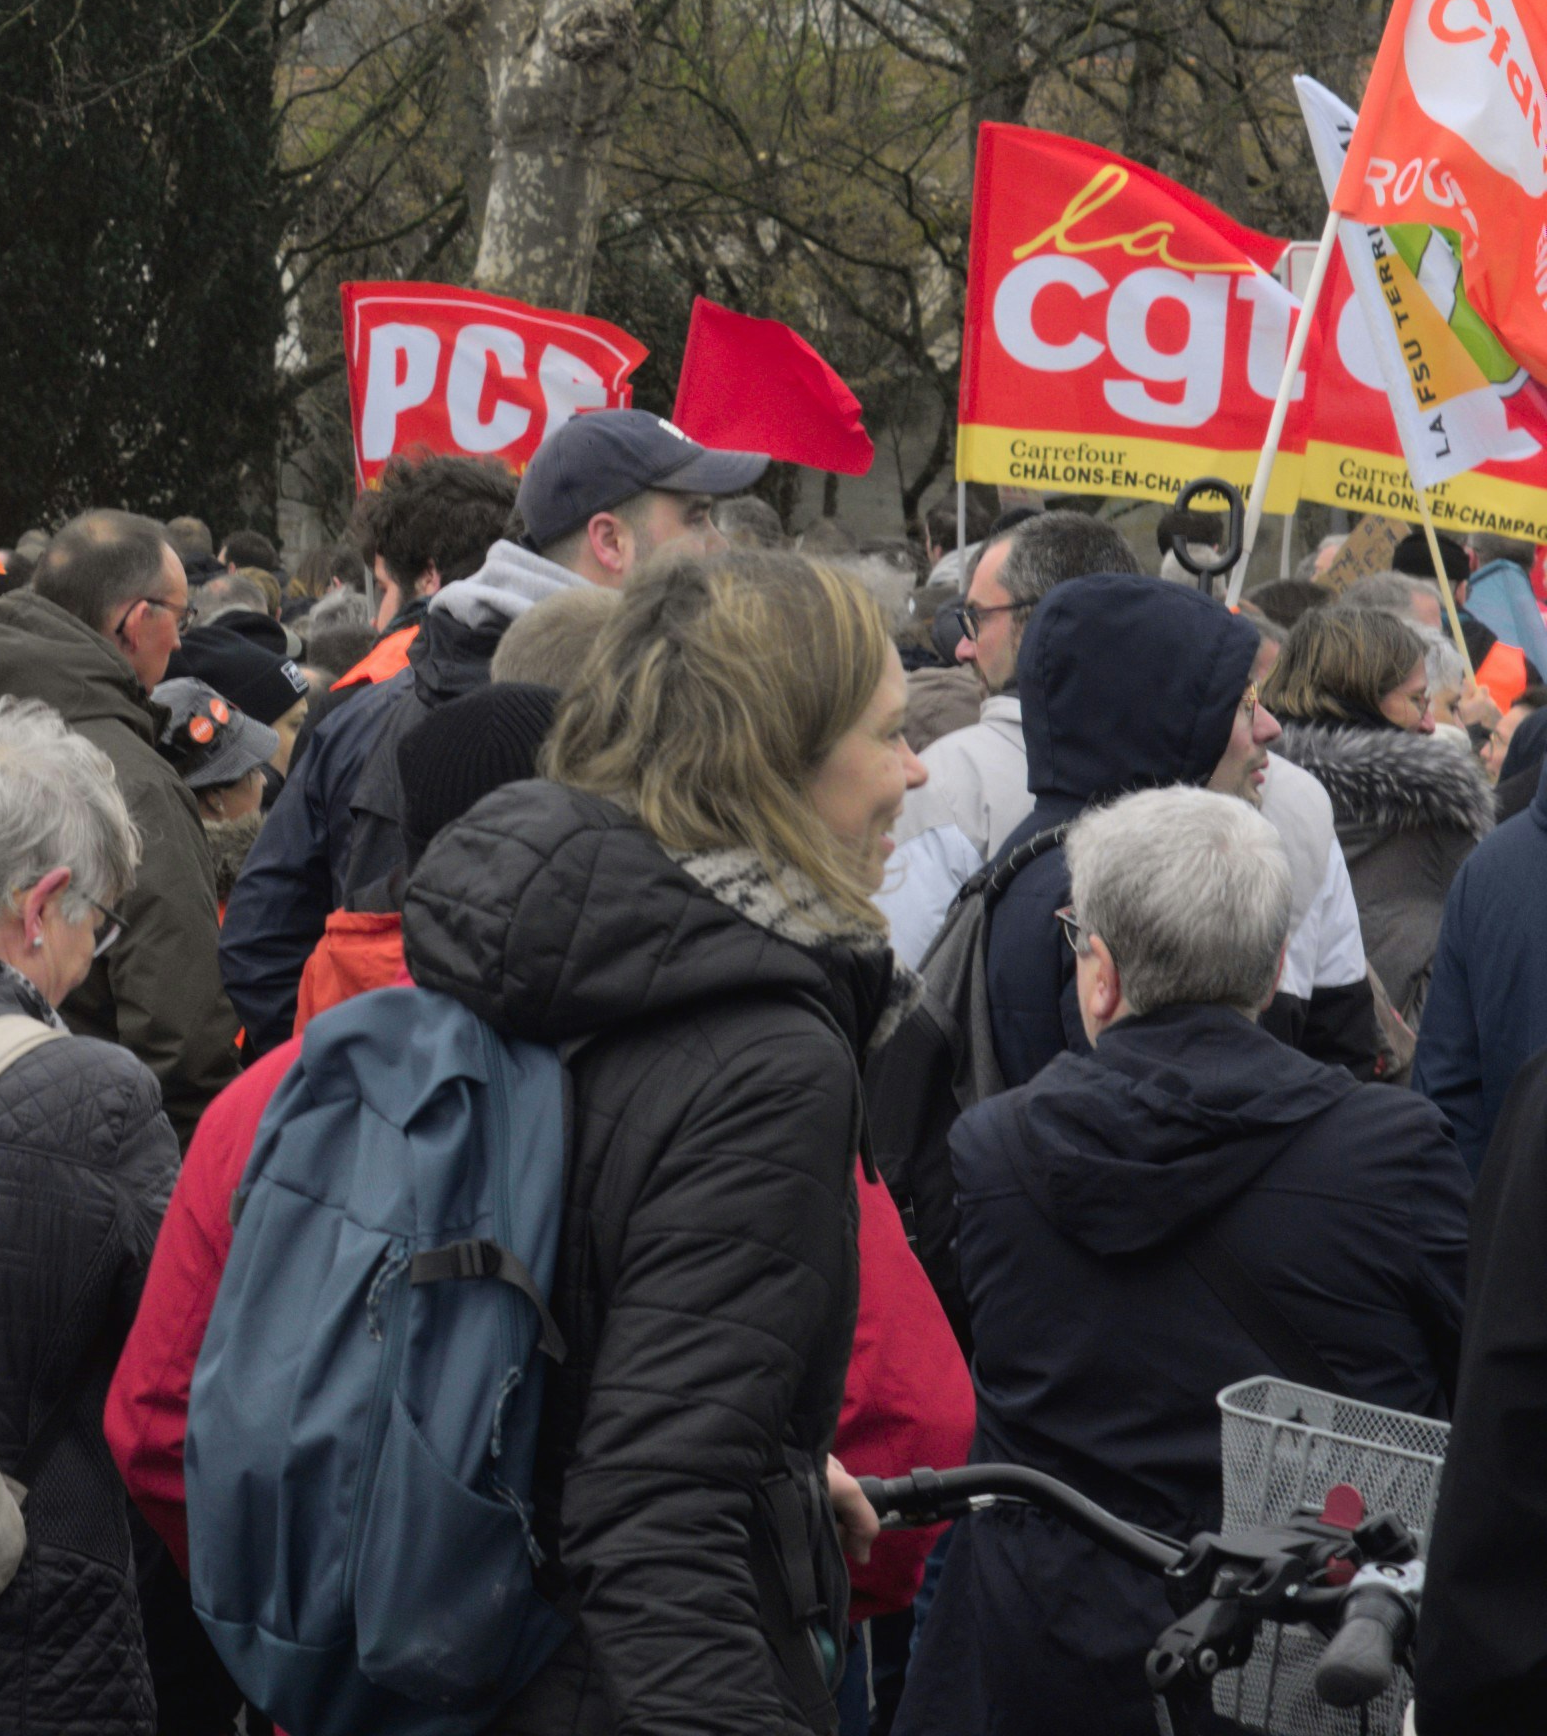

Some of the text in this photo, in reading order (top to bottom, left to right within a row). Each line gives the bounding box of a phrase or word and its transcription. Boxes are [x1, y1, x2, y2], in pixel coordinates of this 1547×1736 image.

[1013, 164, 1217, 270] la
[993, 254, 1306, 428] cgt
[1404, 339, 1436, 406] FSU
[1010, 439, 1127, 465] Carrefour
[1428, 413, 1451, 459] LA
